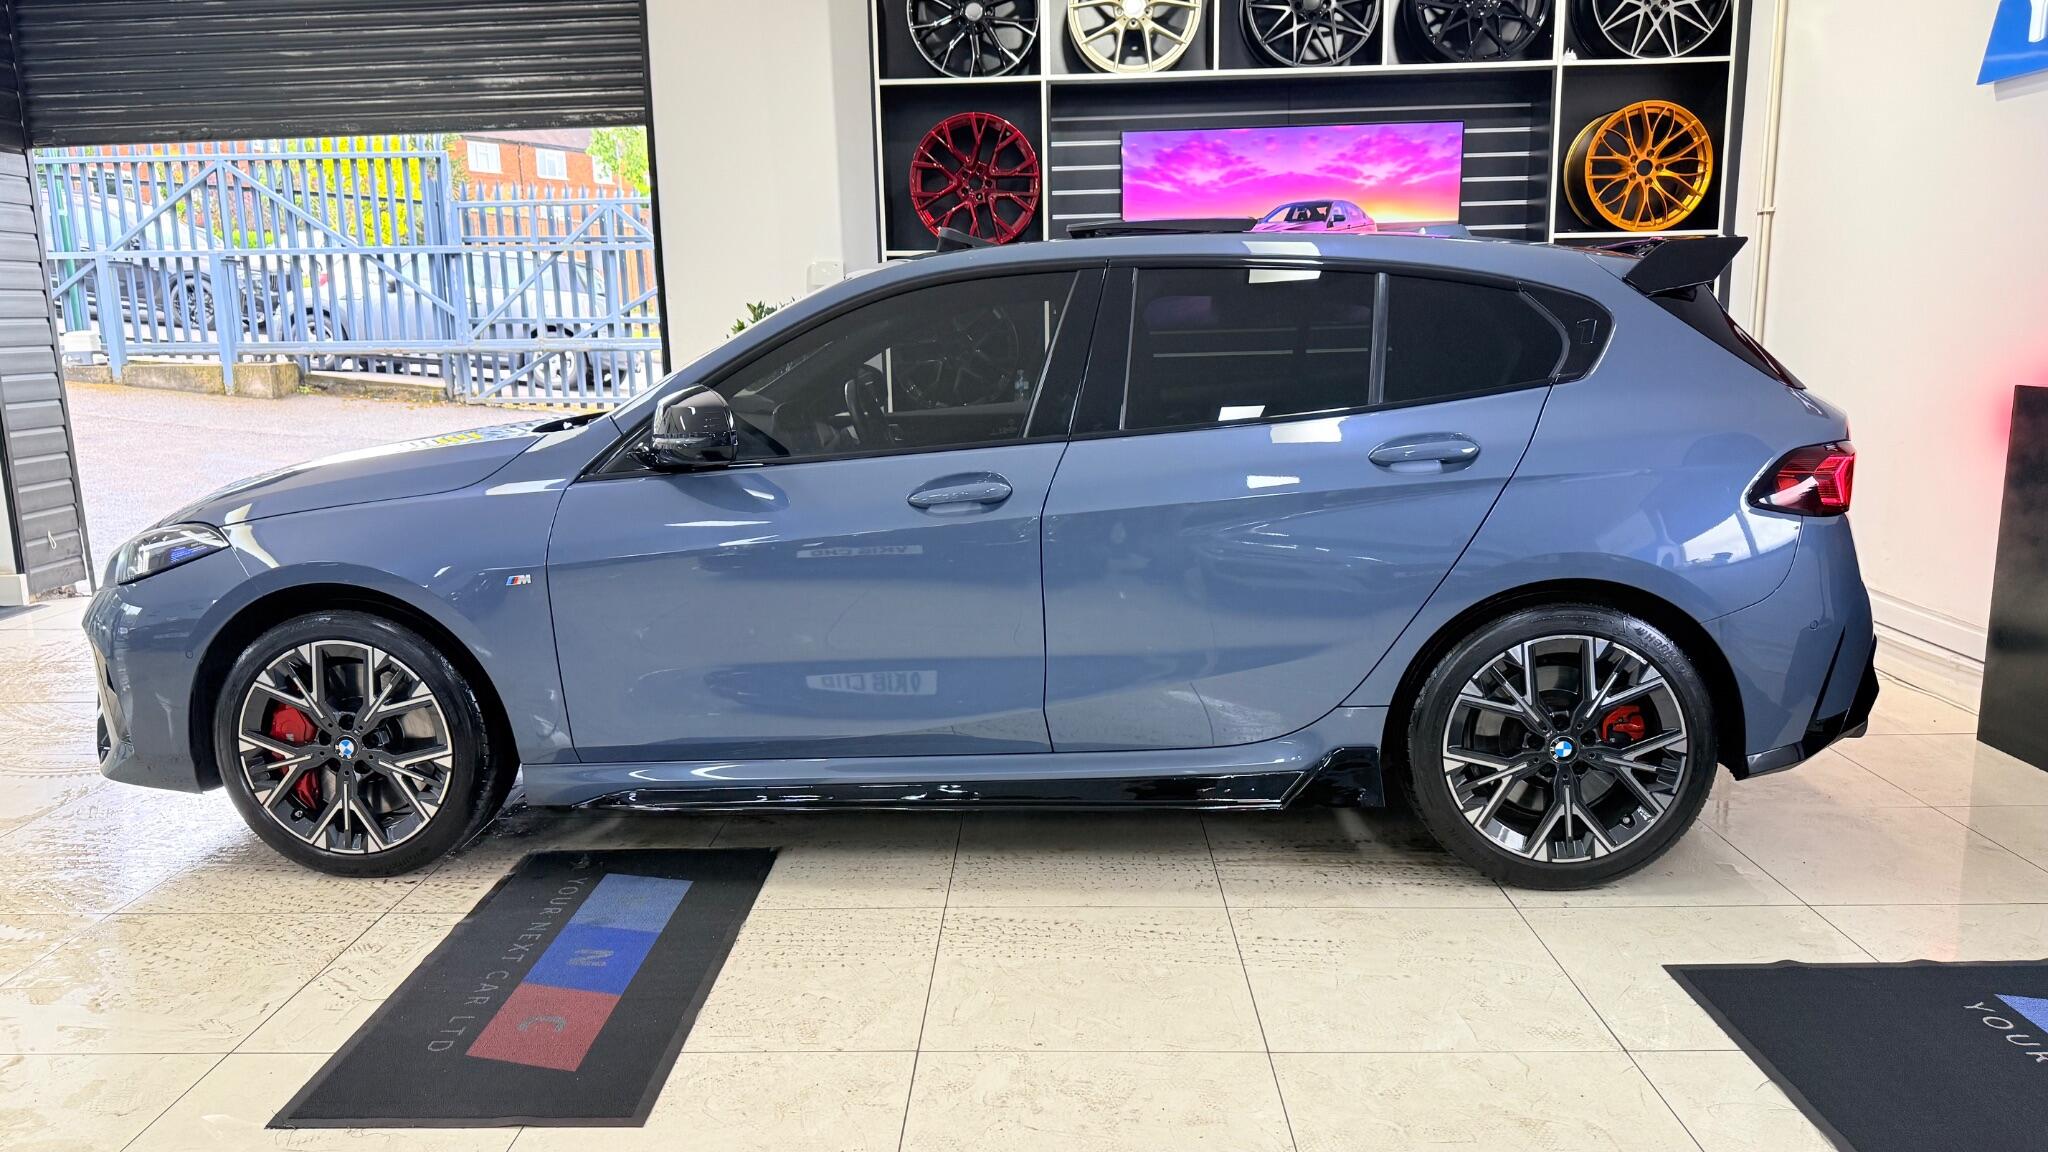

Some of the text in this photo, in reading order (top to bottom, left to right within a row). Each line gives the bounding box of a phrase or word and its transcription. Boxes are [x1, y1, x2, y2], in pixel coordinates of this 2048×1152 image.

[427, 877, 589, 1052] YOUR NEXT CAR LTD
